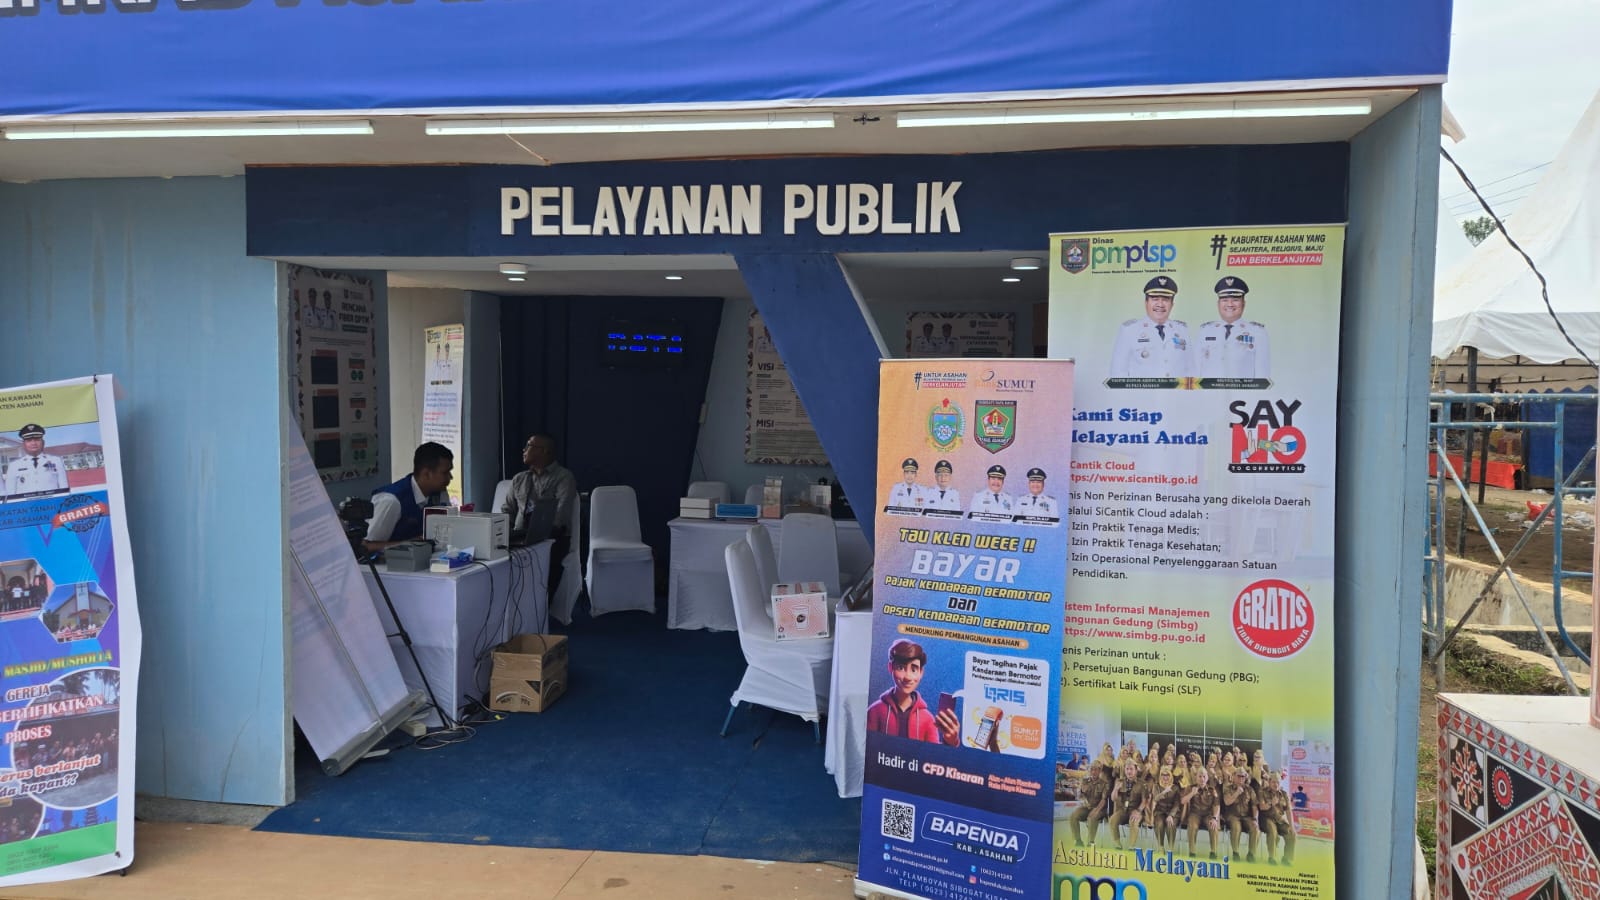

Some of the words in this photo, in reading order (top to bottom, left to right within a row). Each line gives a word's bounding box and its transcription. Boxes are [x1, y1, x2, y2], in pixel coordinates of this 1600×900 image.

[500, 185, 762, 236] PELAYANAN
[784, 181, 963, 236] PUBLIK
[1231, 235, 1273, 244] KABUPATEN
[1274, 234, 1304, 244] ASAHAN
[1306, 234, 1326, 243] YANG
[1229, 256, 1248, 265] DAN
[1249, 254, 1322, 264] BERKELANJUTAN
[757, 362, 775, 371] VISI
[996, 380, 1036, 389] SUMUT
[1118, 408, 1163, 425] Siap
[1229, 399, 1302, 429] SAY
[756, 419, 775, 428] MISI
[1155, 431, 1208, 445] Anda
[1232, 423, 1307, 464] NO
[1070, 460, 1102, 470] Cantik
[1105, 461, 1136, 471] Cloud
[1070, 473, 1198, 485] tps://www.sicantik.go.id
[1084, 491, 1105, 500] Non
[1107, 491, 1152, 502] Perizinan
[1155, 493, 1200, 503] Berusaha
[1203, 496, 1228, 506] yang
[1231, 495, 1271, 506] dikelola
[1274, 496, 1311, 506] Daerah
[59, 503, 102, 522] GRATIS
[1067, 507, 1093, 516] elalui
[1095, 507, 1135, 517] SiCantik
[1138, 508, 1167, 518] Cloud
[1169, 510, 1203, 520] adalah
[1072, 522, 1089, 531] Izin
[1092, 522, 1124, 533] Praktik
[1129, 524, 1164, 536] Tenaga
[1167, 525, 1201, 535] Medis;
[974, 536, 1019, 552] WEEE
[1071, 538, 1089, 547] Izin
[1092, 538, 1125, 548] Praktik
[1129, 540, 1164, 551] Tenaga
[1167, 541, 1221, 553] Kesehatan;
[1071, 553, 1089, 562] Izin
[1092, 554, 1150, 566] Operasional
[1153, 557, 1239, 569] Penyelenggaraan
[1242, 559, 1277, 570] Satuan
[1072, 568, 1128, 580] Pendidikan.
[1064, 601, 1092, 612] istem
[1095, 603, 1145, 614] Informasi
[1148, 606, 1210, 619] Manajemen
[1239, 586, 1308, 630] GRATIS
[1064, 615, 1110, 625] angunan
[1112, 616, 1154, 629] Gedung
[1156, 619, 1199, 632] (Simbg)
[904, 625, 944, 637] MENDUKUNG
[944, 630, 991, 645] PEMBANGUNAN
[991, 637, 1021, 648] ASAHAN
[1064, 627, 1206, 644] ttps://www.simbg.pu.go.id
[1062, 646, 1081, 655] enis
[1084, 646, 1129, 658] Perizinan
[1131, 649, 1161, 661] untuk
[972, 656, 990, 665] Bayar
[991, 659, 1017, 668] Tagihan
[1018, 662, 1038, 671] Pajak
[972, 666, 1007, 676] Kendaraan
[1008, 671, 1042, 680] Bermotor
[1073, 661, 1130, 675] Persetujuan
[1133, 666, 1183, 678] Bangunan
[1185, 669, 1226, 682] Gedung
[1229, 672, 1260, 684] (PBG);
[6, 683, 50, 702] GEREJA
[1073, 677, 1116, 689] Sertifikat
[1119, 680, 1139, 691] Laik
[1142, 683, 1174, 695] Fungsi
[1177, 684, 1202, 696] (SLF)
[5, 724, 53, 744] PROSES
[0, 768, 32, 783] erus
[34, 754, 100, 778] berlanjut
[877, 752, 906, 770] Hadir
[908, 759, 919, 772] di
[922, 762, 945, 778] CFD
[945, 767, 984, 785] Kisaran
[20, 772, 78, 794] kapan??
[930, 816, 1019, 851] BAPENDA
[979, 848, 1013, 863] ASAHAN
[1053, 840, 1128, 870] Asahan
[1135, 848, 1230, 882] Melayani
[902, 872, 948, 889] FLAMBOYAN
